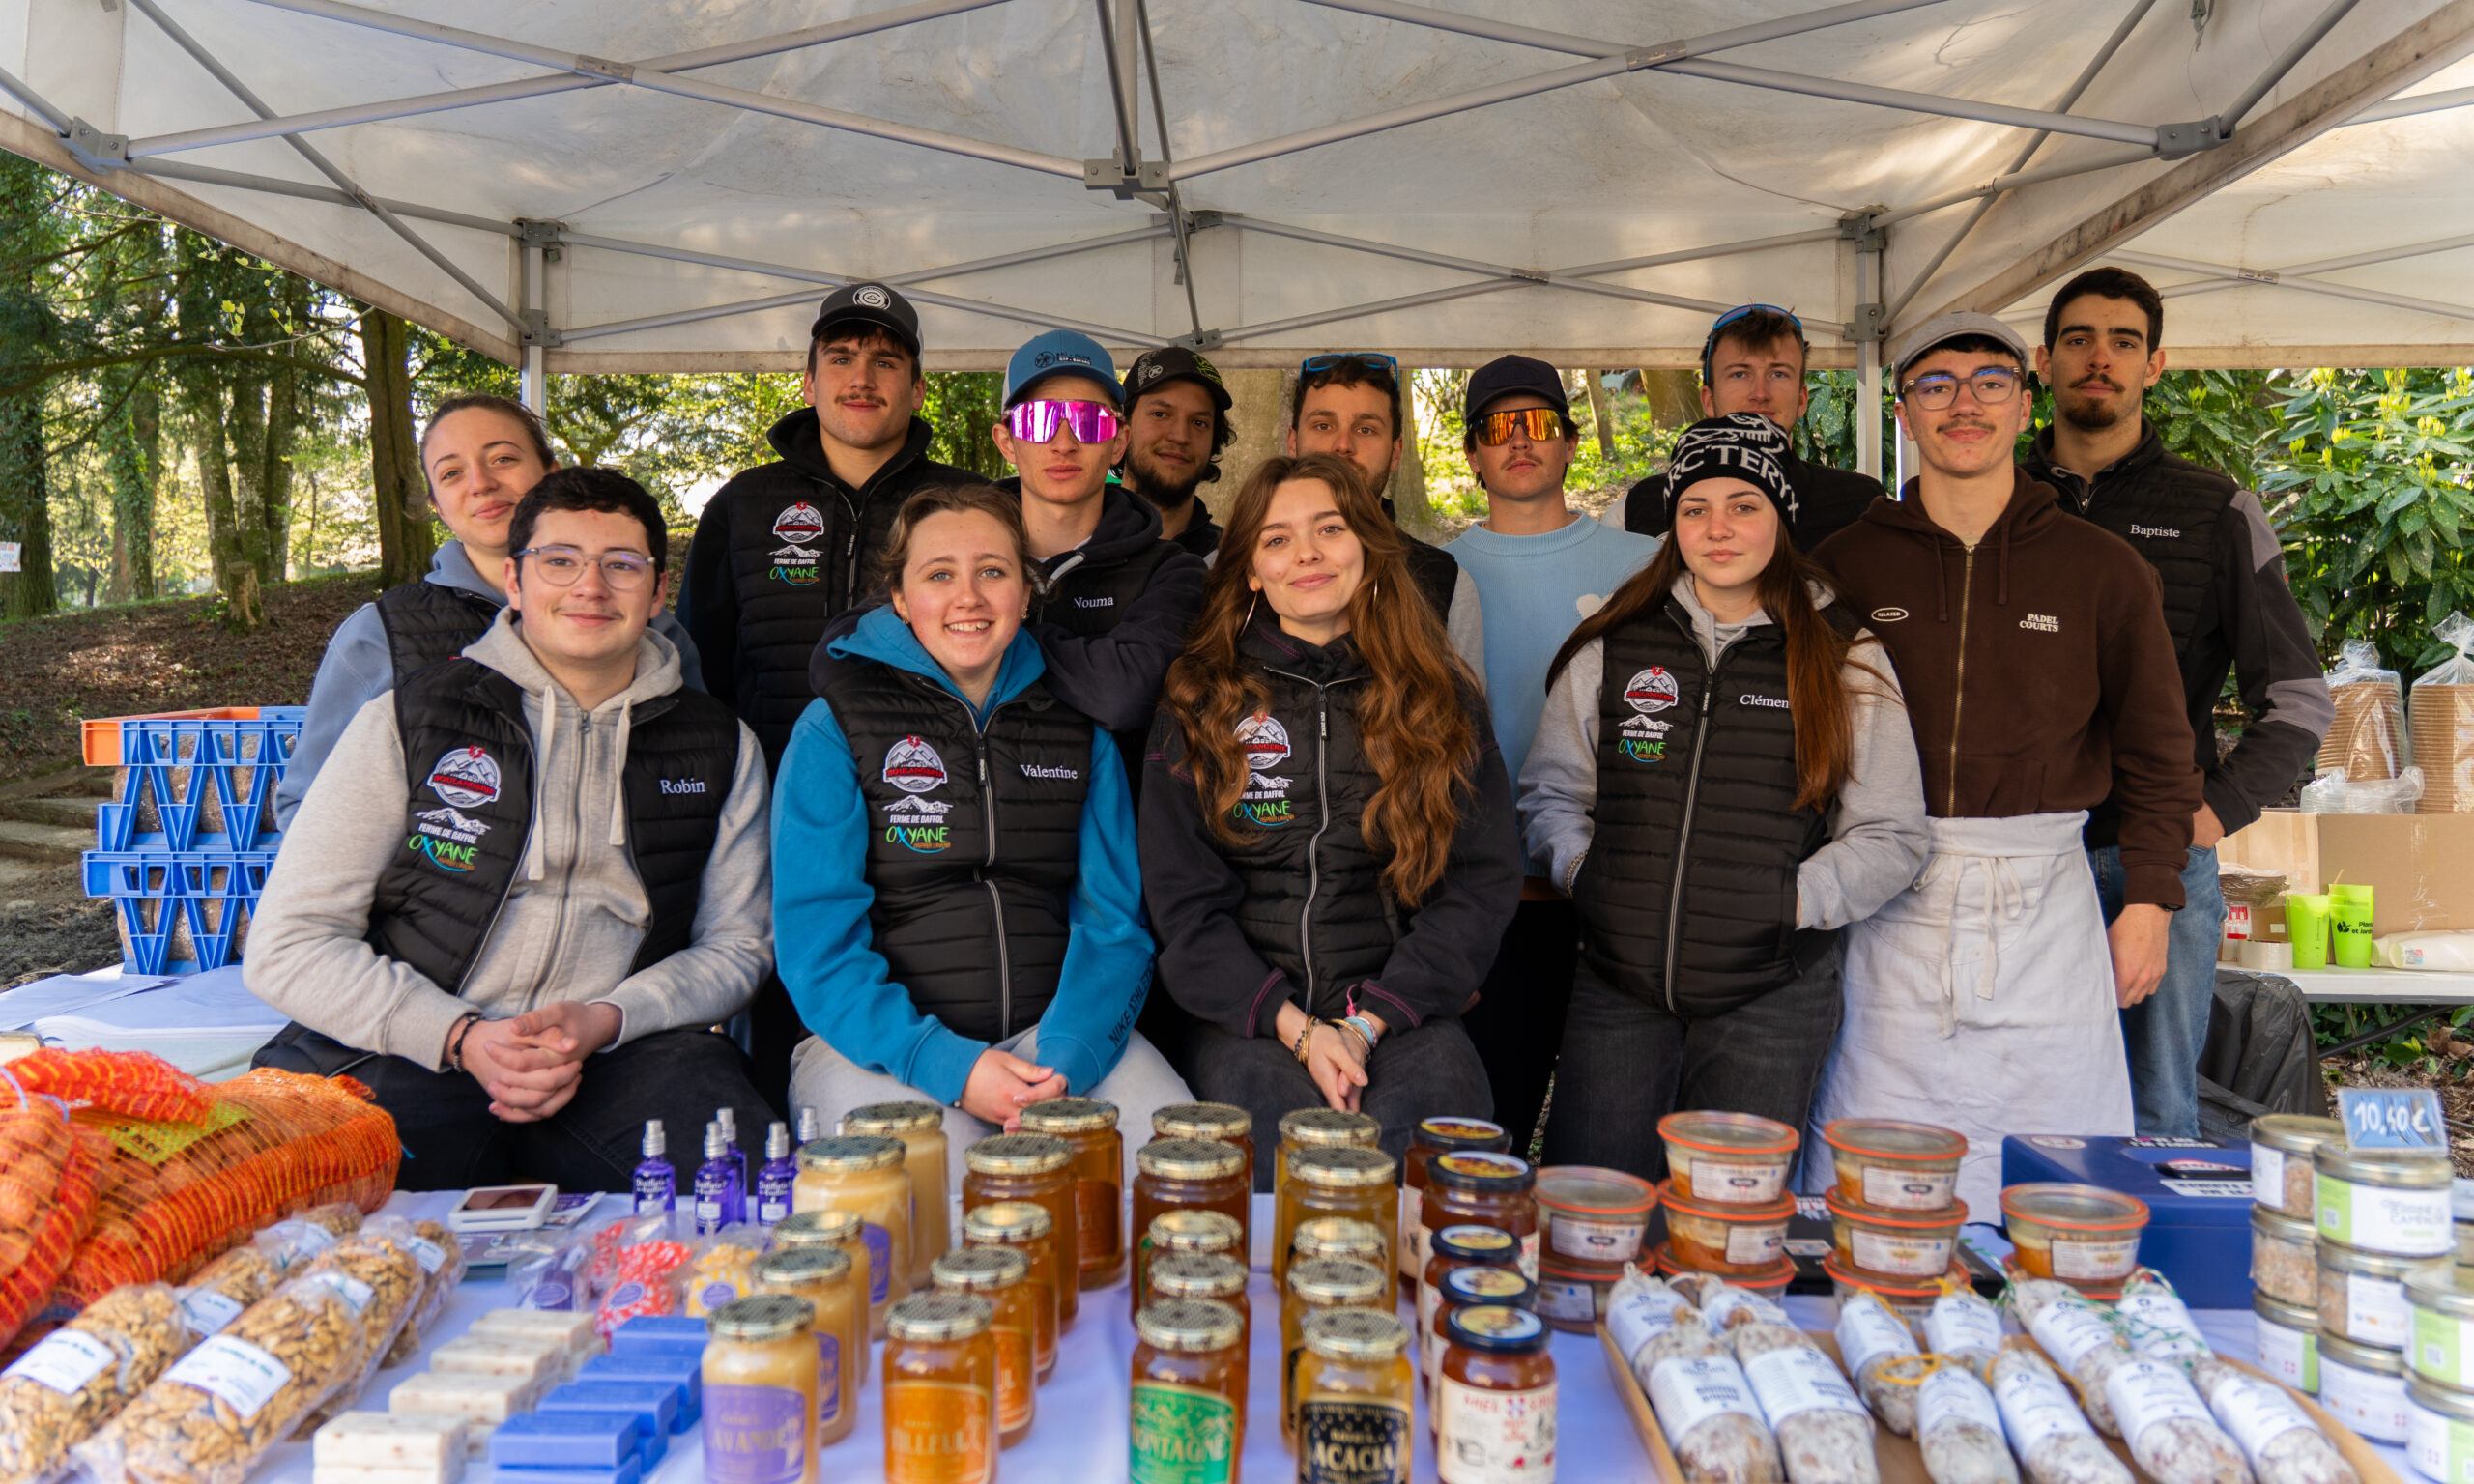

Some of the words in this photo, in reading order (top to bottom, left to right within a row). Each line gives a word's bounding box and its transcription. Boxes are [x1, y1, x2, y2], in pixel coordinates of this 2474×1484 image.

[2129, 524, 2180, 538] Baptiste
[769, 566, 820, 580] OXYANE
[2019, 620, 2059, 632] COURTS
[2027, 613, 2059, 624] PADEL
[1740, 694, 1790, 709] Clémen
[1618, 738, 1667, 756] OXYANE
[1021, 764, 1078, 780] Valentine
[659, 778, 706, 794] Robin
[1232, 800, 1292, 819] OXYANE
[910, 814, 920, 824] DE
[885, 825, 950, 844] OXYANE
[408, 834, 480, 866] OXYANE
[1108, 1010, 1133, 1048] NIKE
[1134, 1429, 1227, 1463] ONTAGNE
[1312, 1440, 1395, 1473] ACACIA
